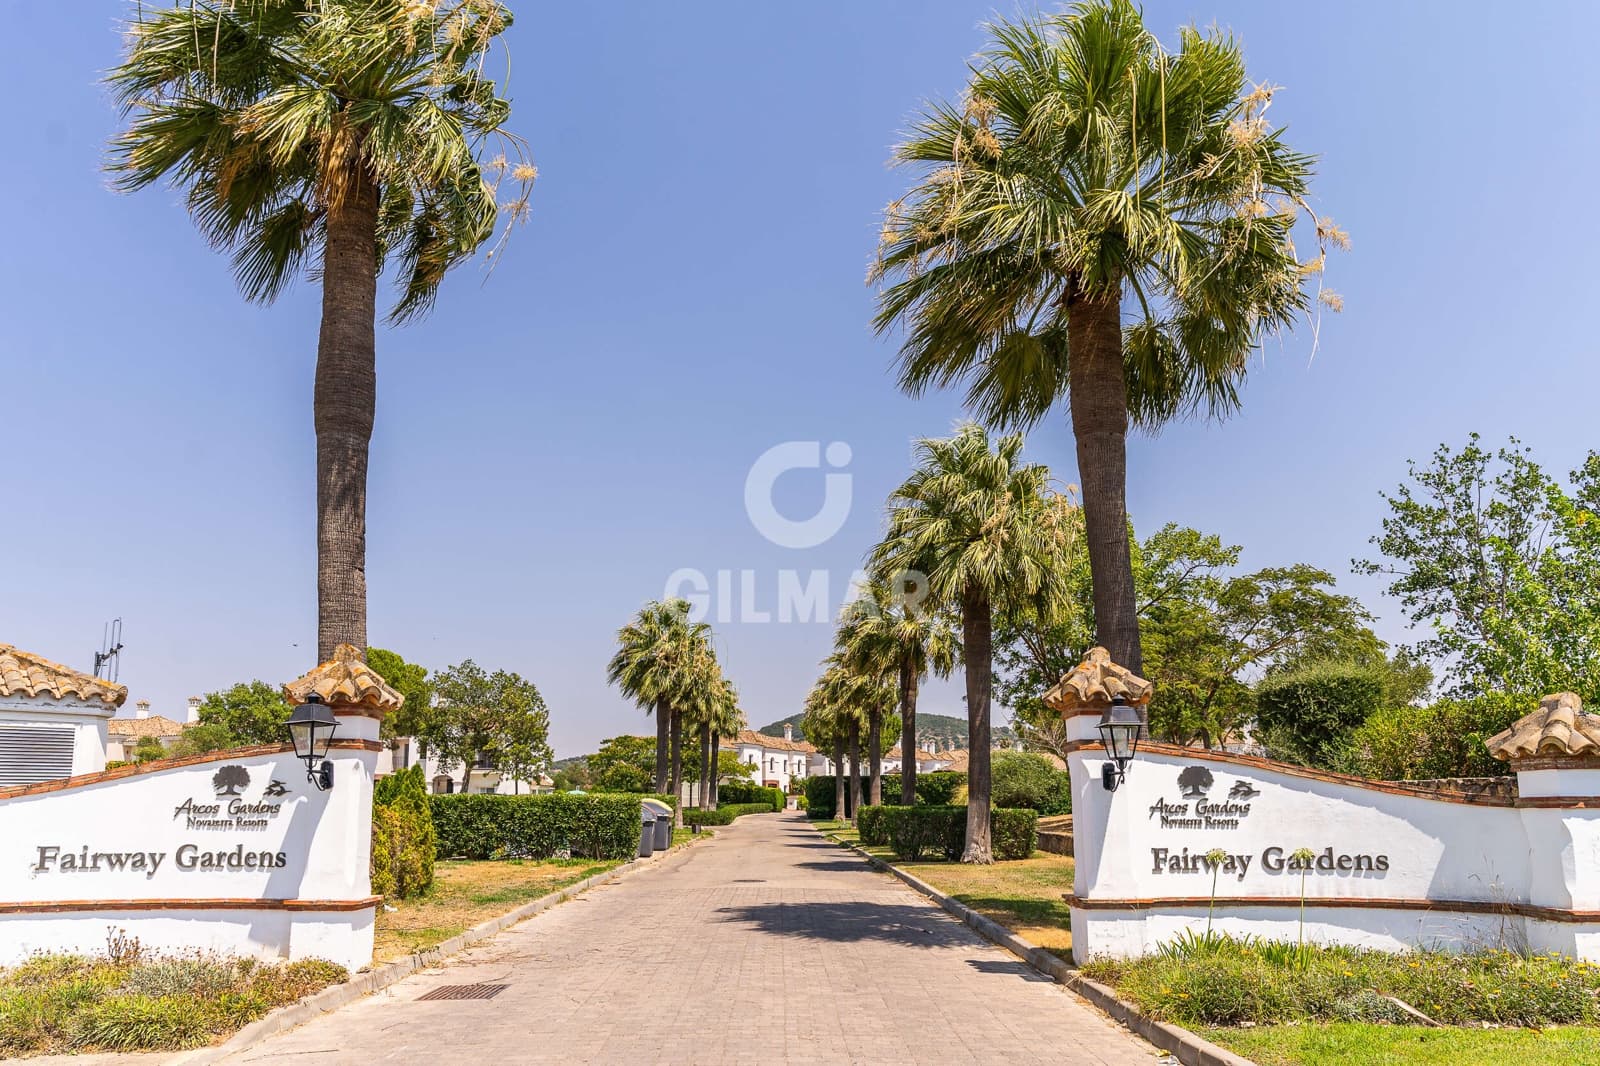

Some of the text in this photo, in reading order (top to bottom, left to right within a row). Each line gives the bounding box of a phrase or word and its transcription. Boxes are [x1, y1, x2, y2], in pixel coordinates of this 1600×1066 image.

[174, 797, 281, 819] Arcos Gardens
[1149, 797, 1251, 820] Arcos Gardens
[1205, 816, 1239, 826] Resorts
[37, 844, 287, 876] Fairway Gardens
[1262, 846, 1390, 871] Gardens
